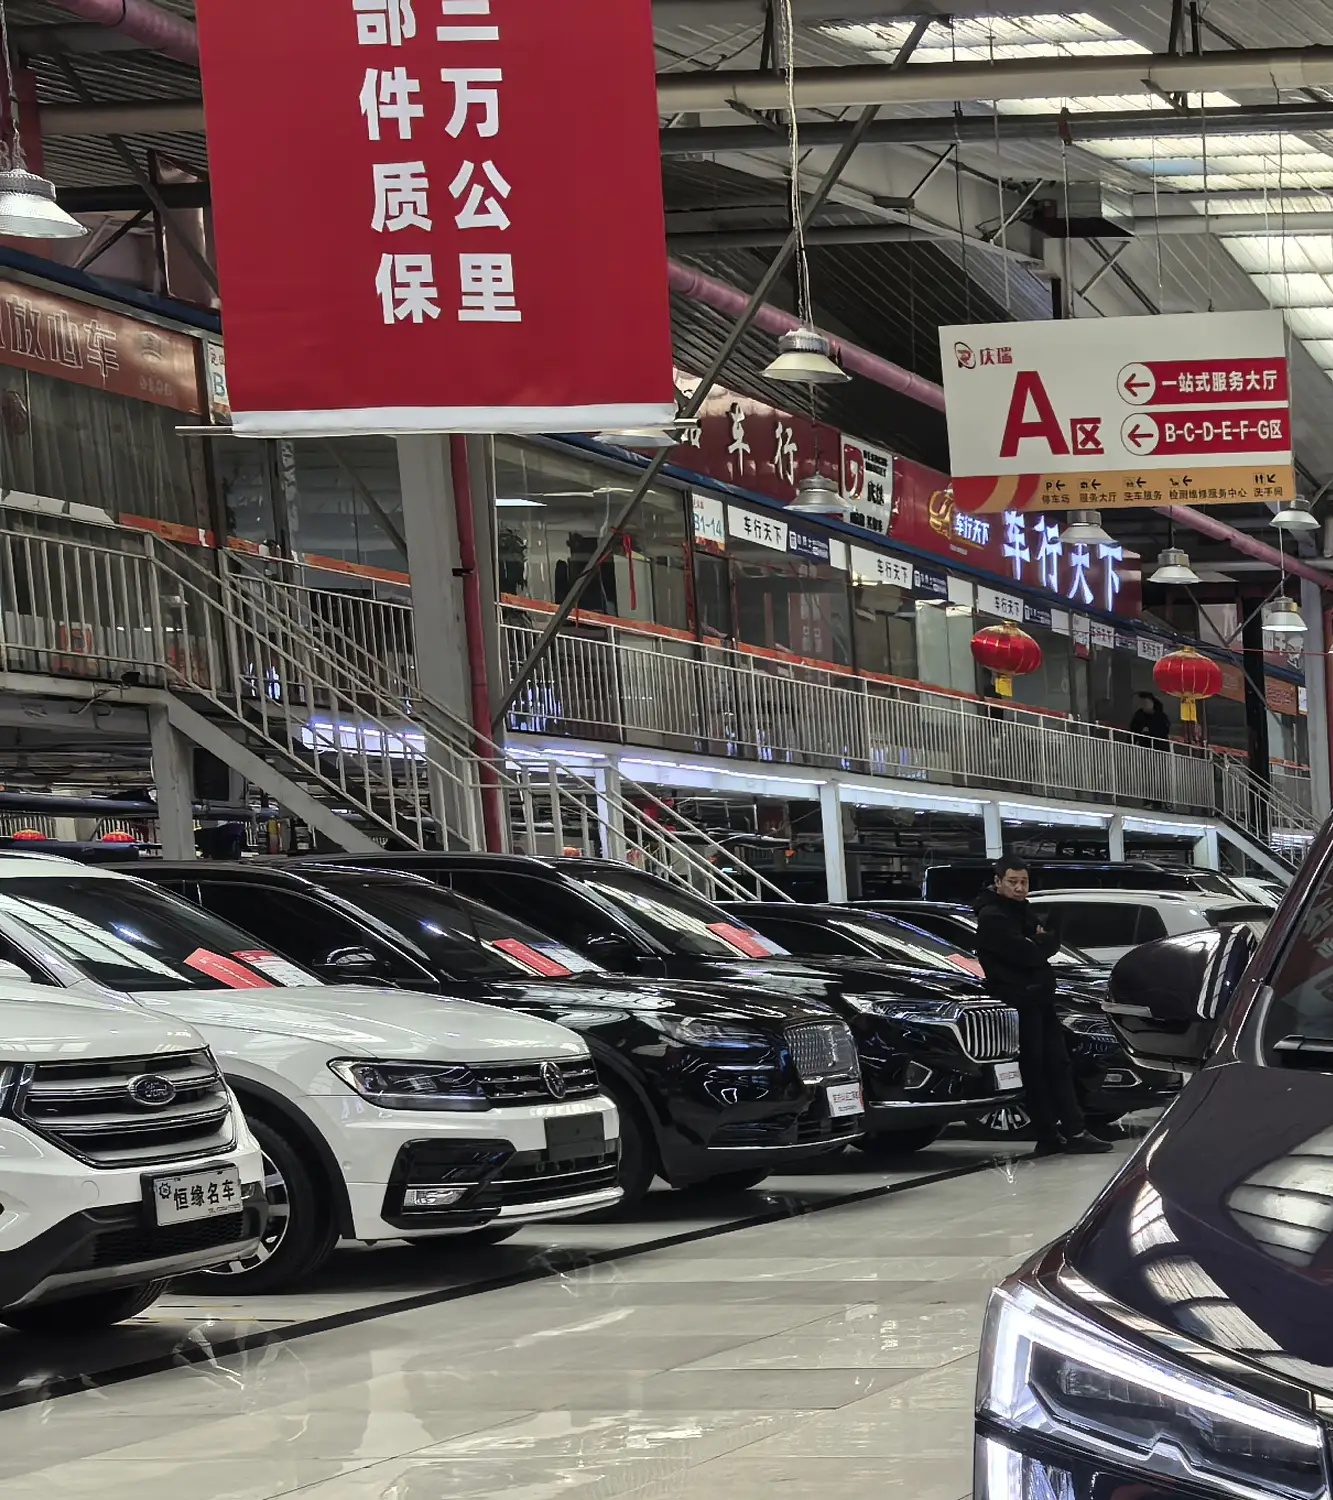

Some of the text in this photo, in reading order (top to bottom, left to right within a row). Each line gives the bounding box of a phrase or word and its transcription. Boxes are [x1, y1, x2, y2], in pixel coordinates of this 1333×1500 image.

[0, 293, 120, 378] 放心车
[1161, 369, 1278, 393] 一站式服务大厅
[1165, 418, 1283, 444] B-C-D-E-F-G区
[1079, 491, 1117, 503] 服务大厅
[743, 516, 782, 545] 车行天下
[1003, 510, 1123, 612] 车行天下
[173, 1179, 235, 1212] 恒缘名车
